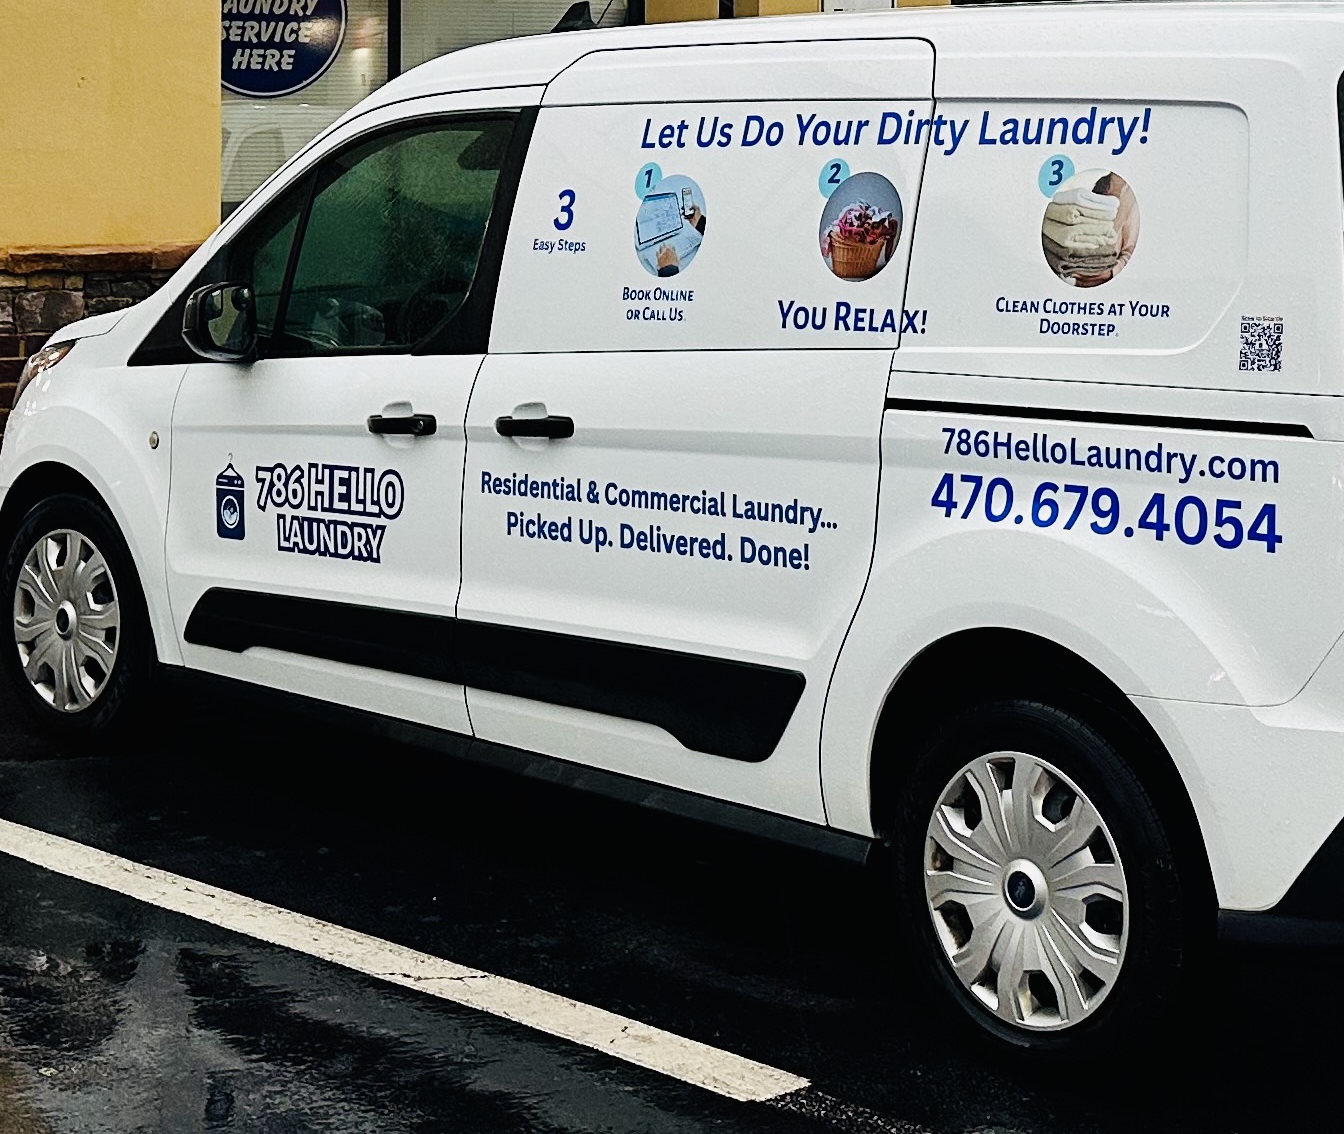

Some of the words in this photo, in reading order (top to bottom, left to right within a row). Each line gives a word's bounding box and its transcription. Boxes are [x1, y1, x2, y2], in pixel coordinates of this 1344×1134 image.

[231, 48, 296, 72] HERE
[641, 118, 689, 149] Let
[696, 116, 734, 148] Us
[741, 115, 785, 147] Do
[796, 113, 870, 146] Your
[877, 109, 970, 156] Dirty
[978, 106, 1152, 156] Laundry!
[644, 168, 654, 189] 1
[827, 163, 842, 184] 2
[1049, 159, 1065, 186] 3
[553, 189, 577, 231] 3
[533, 239, 555, 254] Easy
[557, 238, 587, 254] Steps
[941, 427, 1280, 484] 786HelloLaundry.com
[256, 463, 304, 512] 786
[307, 462, 404, 520] HELLO
[481, 470, 582, 503] Residential
[586, 480, 600, 504] &
[605, 482, 726, 518] Commercial
[732, 493, 839, 534] Laundry...
[930, 472, 1283, 554] 470.679.4054
[276, 513, 387, 563] LAUNDRY
[506, 511, 573, 543] Picked
[578, 518, 613, 553] Up.
[619, 523, 734, 562] Delivered.
[739, 536, 811, 571] Done!
